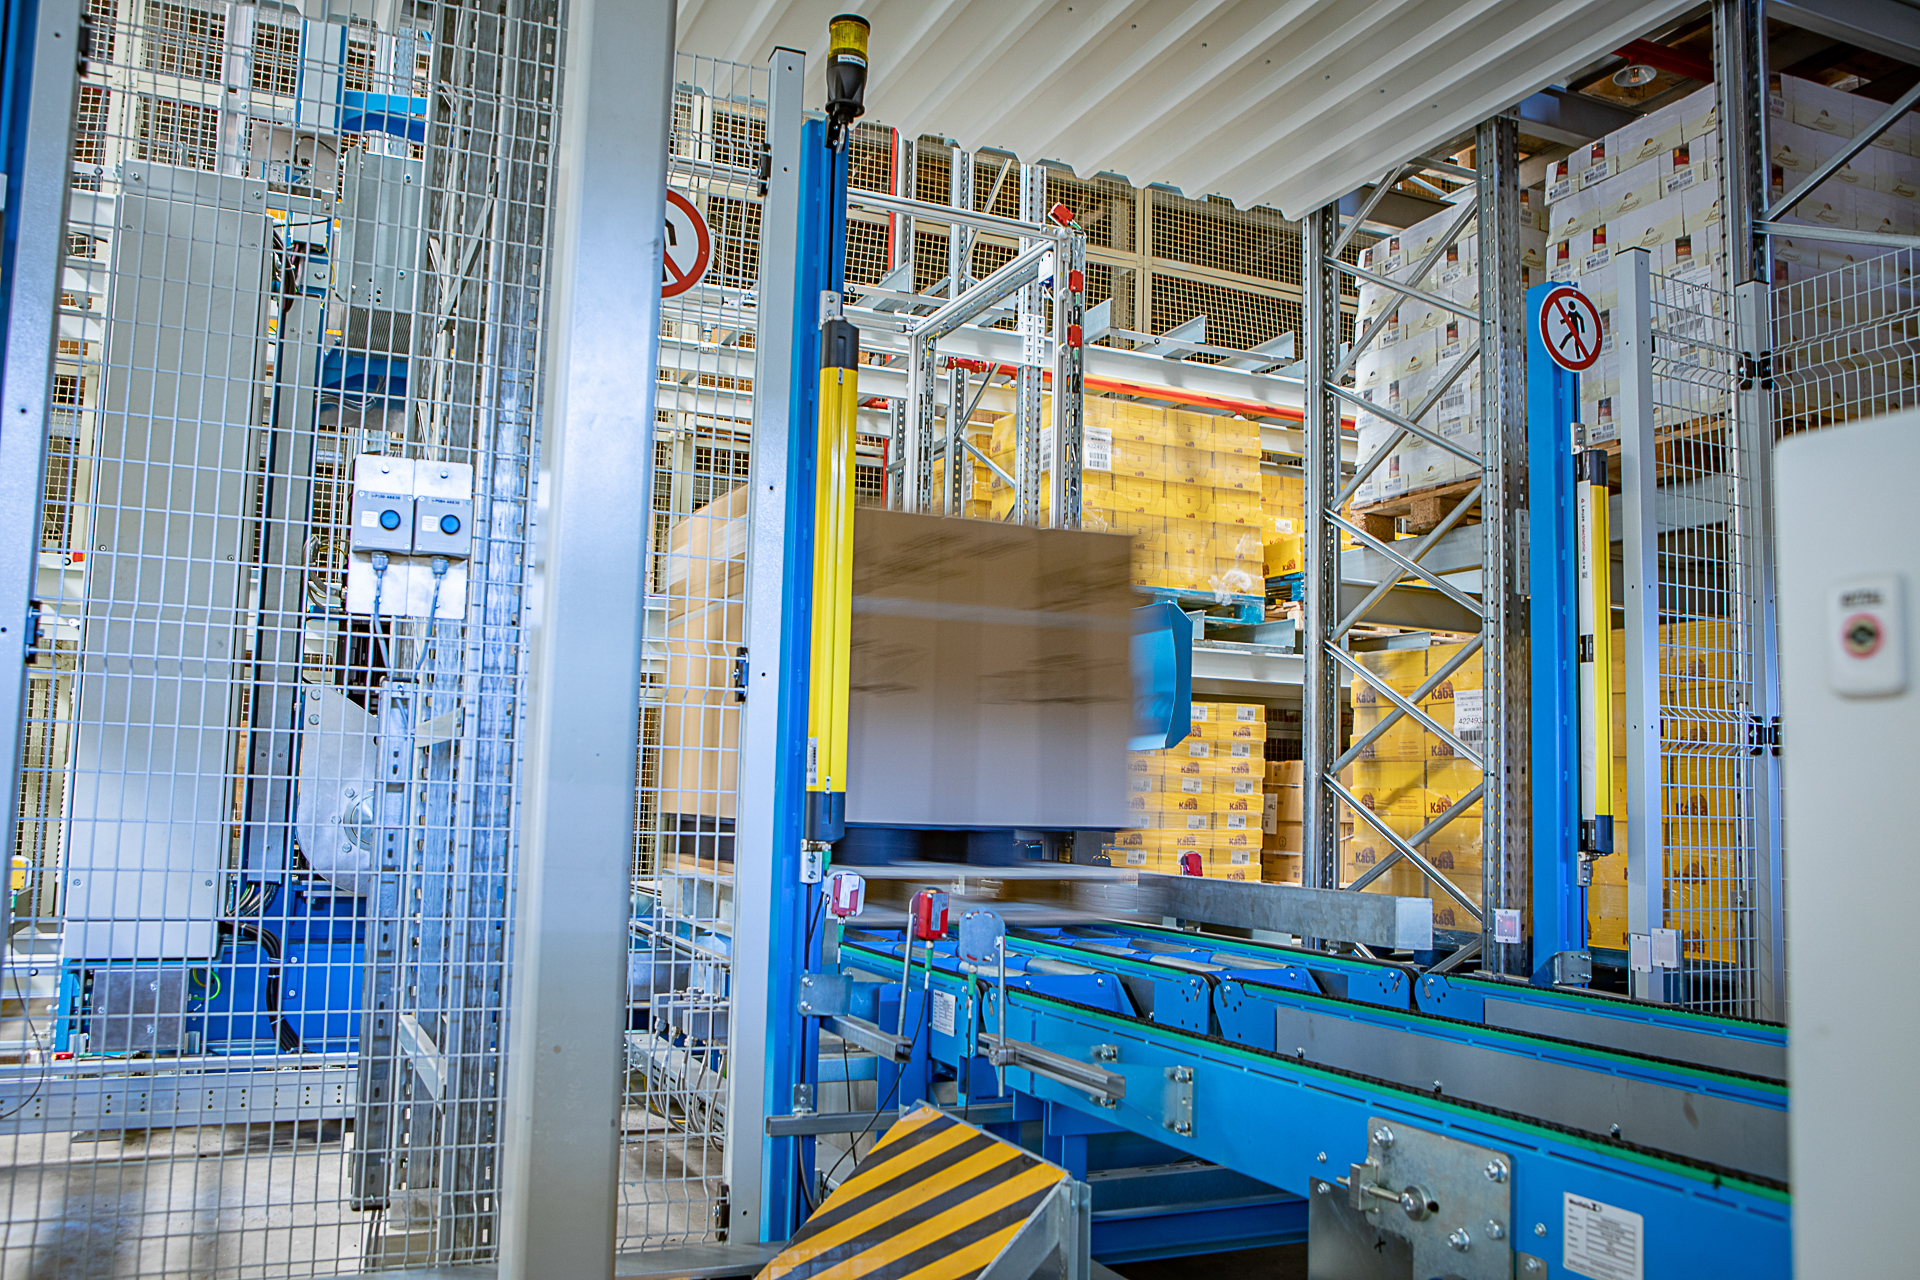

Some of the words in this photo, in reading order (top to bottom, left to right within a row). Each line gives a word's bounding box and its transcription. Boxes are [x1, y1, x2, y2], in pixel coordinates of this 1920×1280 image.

[1356, 692, 1376, 703] Kaba
[1431, 687, 1454, 700] Kaba
[1458, 716, 1483, 725] 422493
[1233, 729, 1251, 738] Kaba
[1431, 745, 1454, 757] Kaba
[1181, 765, 1200, 774] Kaba
[1231, 765, 1249, 774] Kaba
[1178, 801, 1197, 810] Kaba
[1229, 802, 1247, 811] Kaba
[1123, 837, 1142, 846] Kaba
[1177, 838, 1196, 846] Kaba
[1229, 837, 1247, 846] Kaba
[1355, 852, 1376, 864] Kaba
